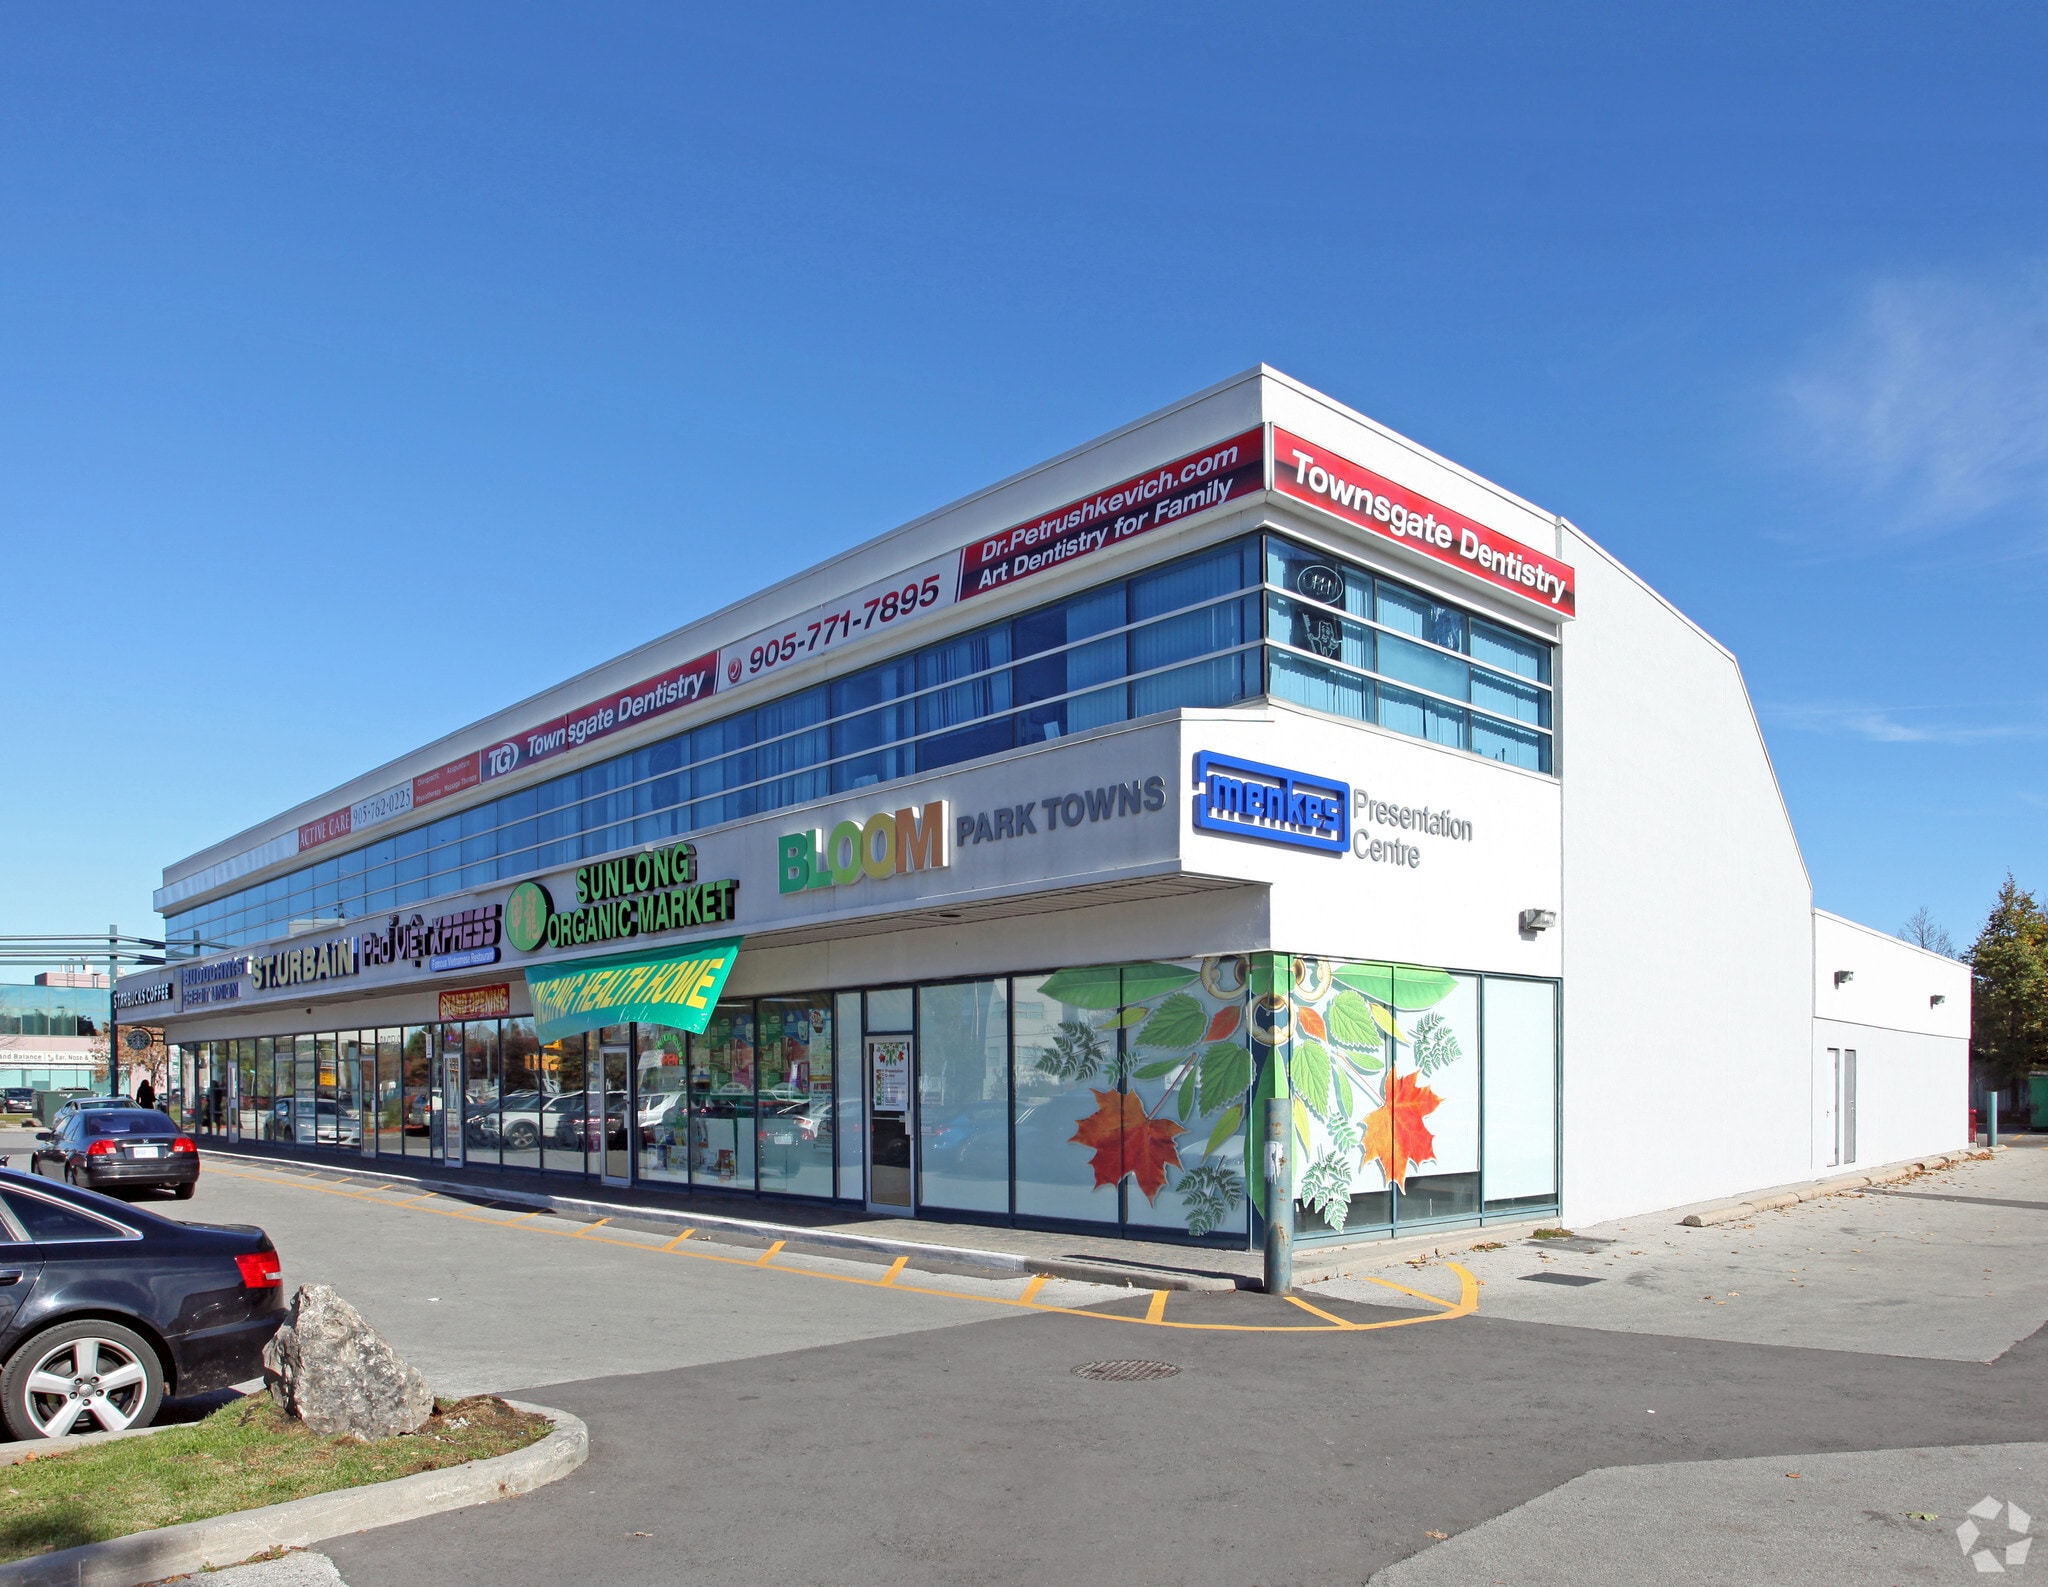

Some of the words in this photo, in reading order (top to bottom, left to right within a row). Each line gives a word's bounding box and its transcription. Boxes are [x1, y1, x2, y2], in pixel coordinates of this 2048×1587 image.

[978, 565, 1008, 590] Art
[1013, 526, 1109, 576] Dentistry
[1114, 511, 1148, 539] for
[1154, 477, 1233, 524] Family
[981, 446, 1238, 562] Dr.Petrushkevich.com
[1292, 449, 1453, 549] Townsgate
[1459, 527, 1566, 604] Dentistry
[749, 573, 941, 674] 905-771-7895
[527, 708, 614, 758] Townsgate
[618, 670, 706, 723] Dentistry
[300, 822, 327, 848] ACTIVE
[329, 811, 350, 836] CARE
[956, 802, 1037, 847] PARK
[1042, 775, 1167, 830] TOWNS
[1207, 774, 1341, 832] menkes
[1353, 788, 1474, 842] Presentation
[576, 843, 697, 904] SUNLONG
[778, 800, 950, 894] BLOOM
[1353, 828, 1421, 869] Centre
[547, 900, 636, 948] ORGANIC
[638, 879, 738, 933] MARKET
[113, 988, 146, 1009] STARBUCKS
[146, 983, 172, 1003] COFFEE
[643, 957, 725, 1010] HOME
